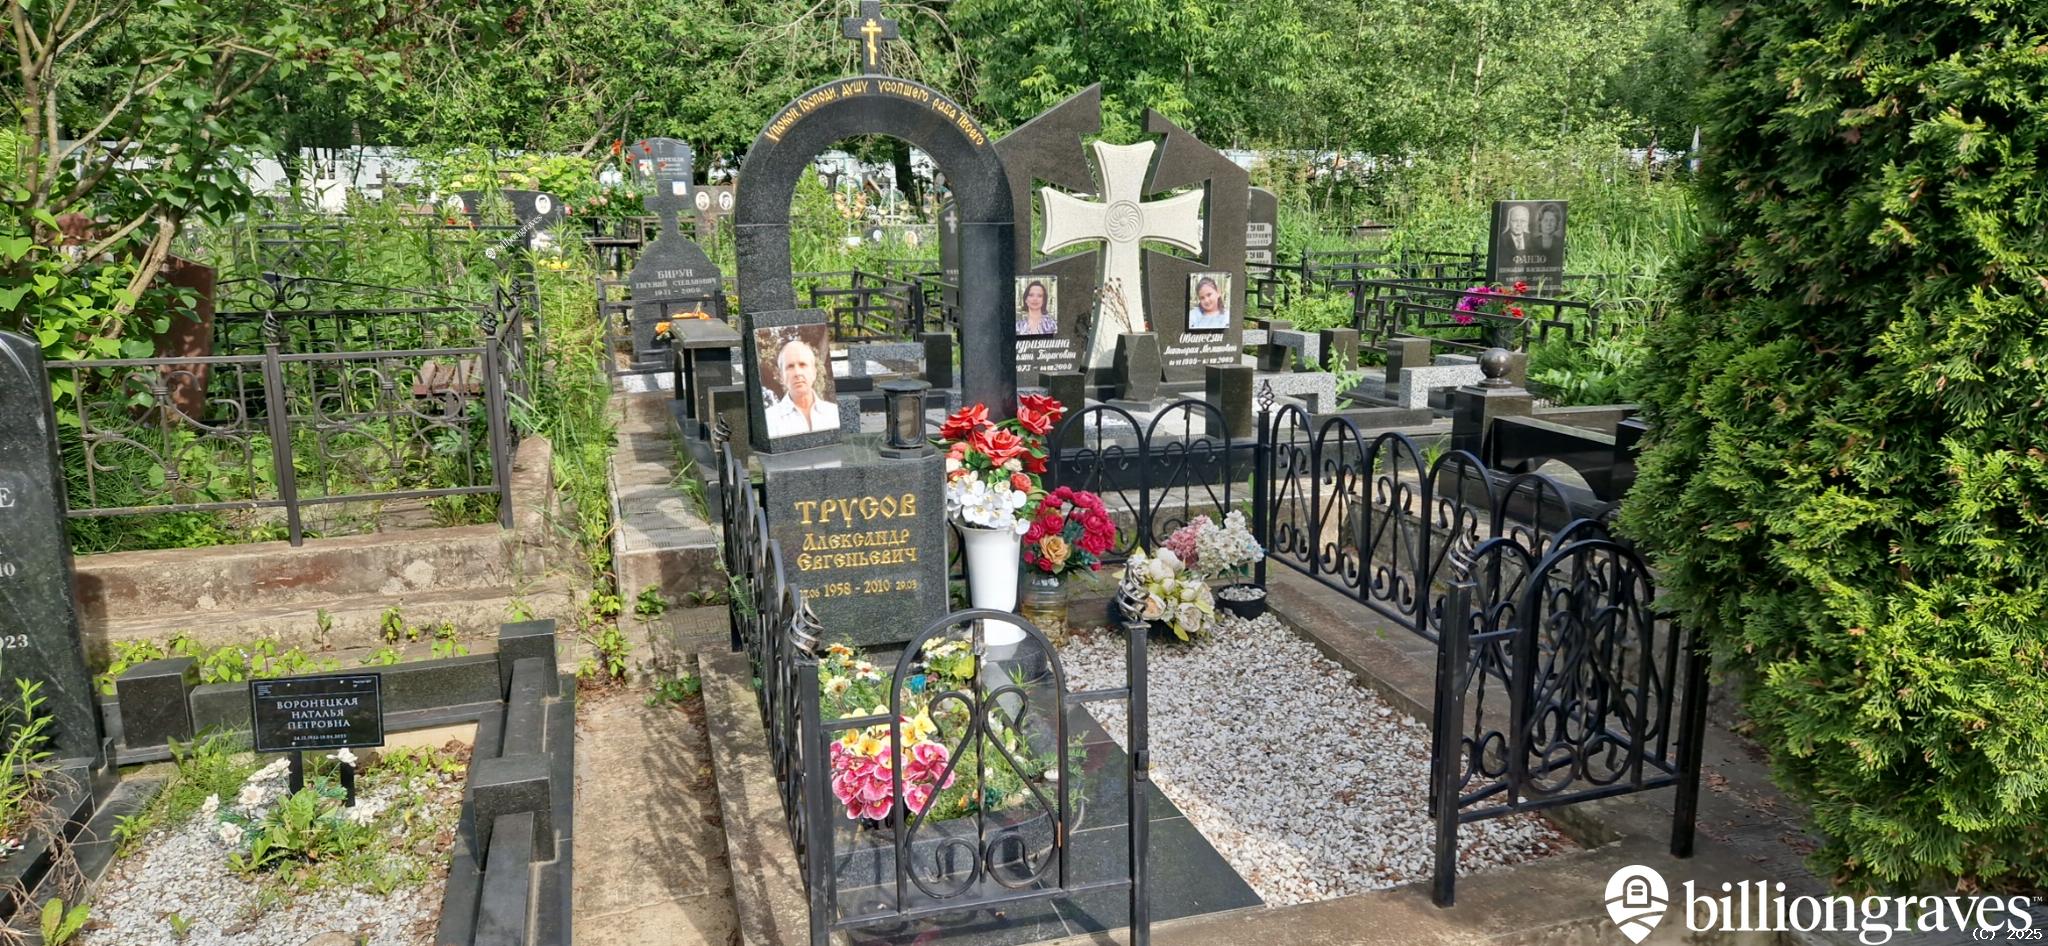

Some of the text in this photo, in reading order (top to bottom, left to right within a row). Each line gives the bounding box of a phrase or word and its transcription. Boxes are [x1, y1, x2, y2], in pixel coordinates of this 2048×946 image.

[656, 269, 693, 279] БИРУН
[793, 493, 917, 528] ТРУСОВ
[824, 581, 851, 598] 1958
[863, 578, 891, 594] 2010
[276, 697, 359, 710] ВОРОНЕЦКАЯ
[291, 708, 345, 719] НАТАЛЬЯ
[287, 719, 351, 730] ПЕТРОВНА
